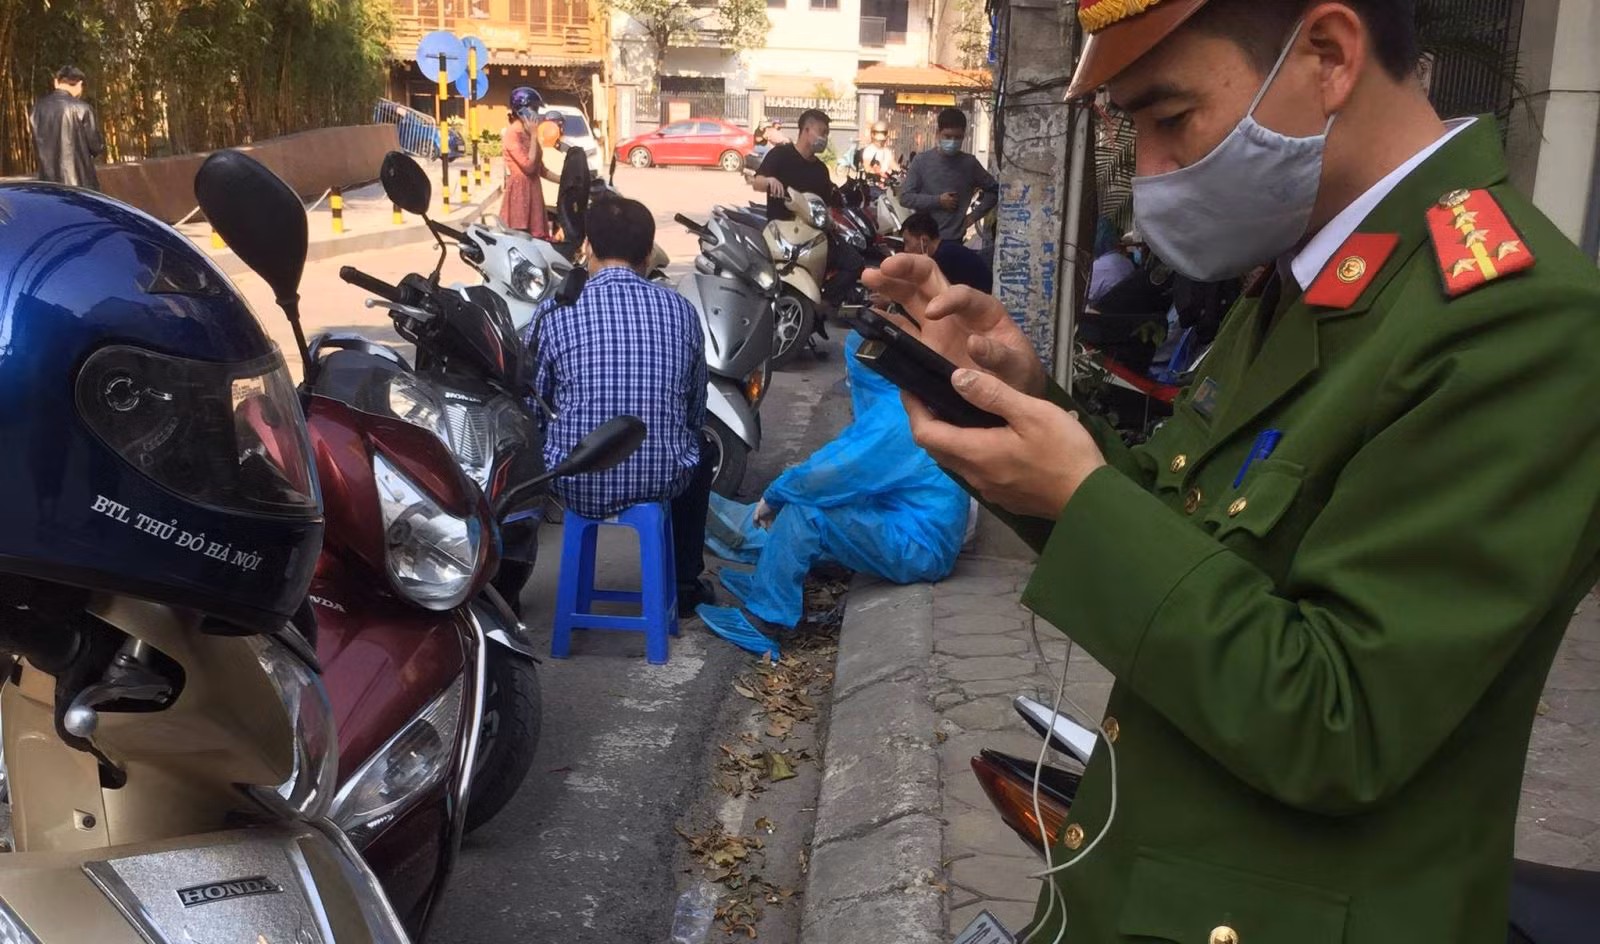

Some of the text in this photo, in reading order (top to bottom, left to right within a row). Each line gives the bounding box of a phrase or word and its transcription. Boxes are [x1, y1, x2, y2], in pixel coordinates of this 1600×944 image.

[90, 494, 263, 572] BTL THỦ ĐÔ HÀ NỘI
[309, 594, 347, 613] NDA
[180, 880, 279, 904] HONDA
